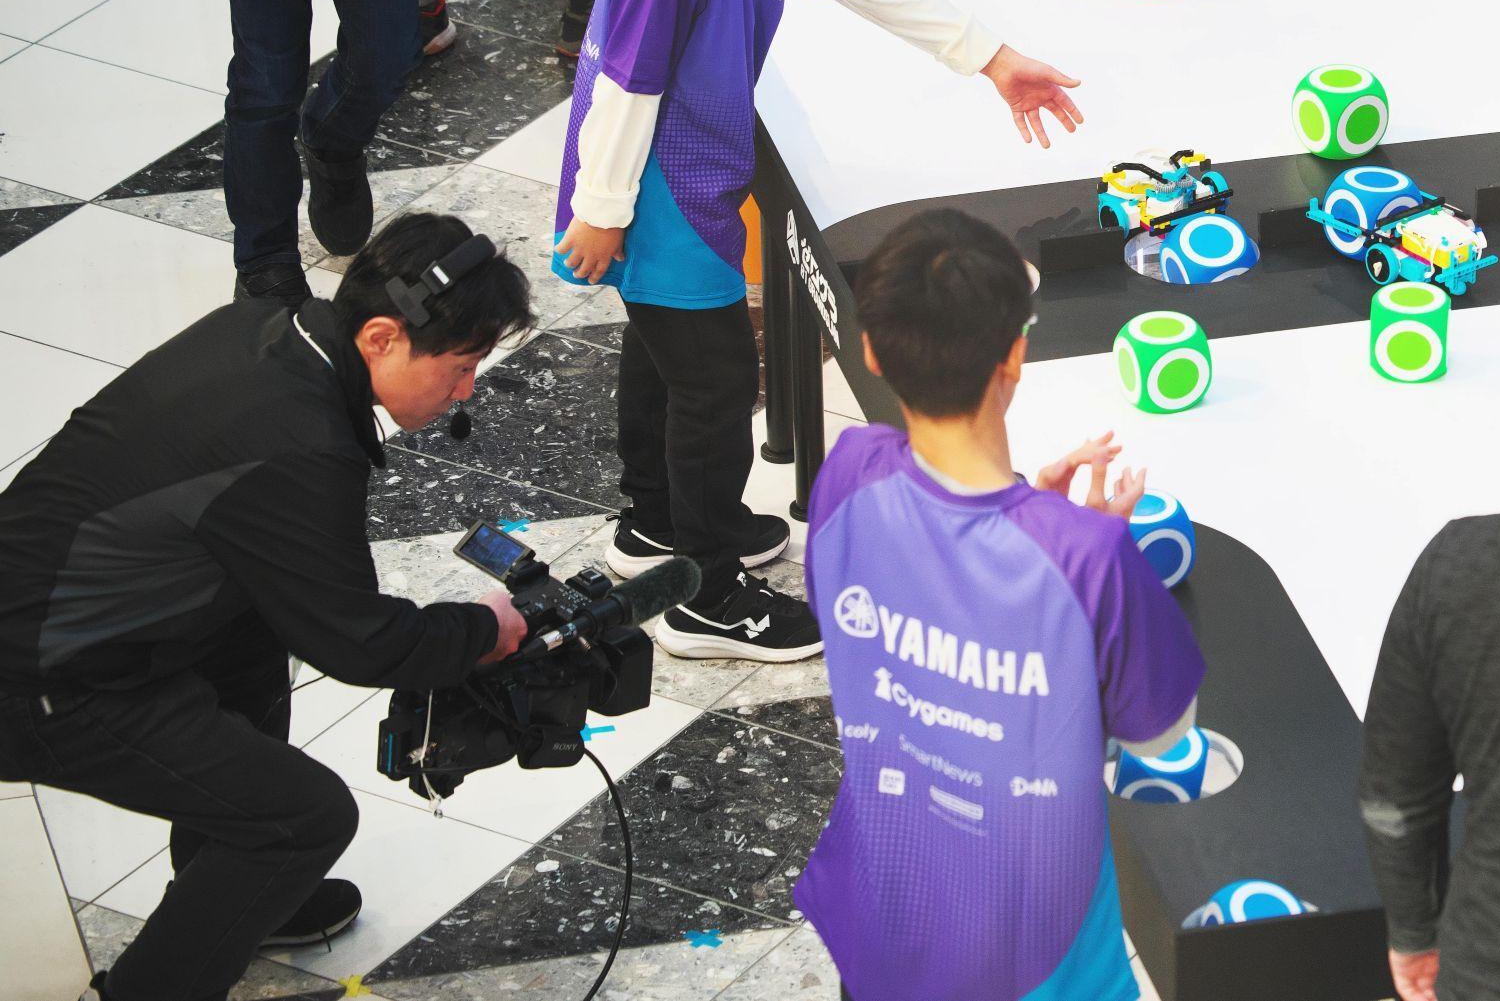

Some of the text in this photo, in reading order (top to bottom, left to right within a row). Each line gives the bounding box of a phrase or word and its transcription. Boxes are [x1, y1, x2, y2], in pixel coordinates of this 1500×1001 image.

[879, 605, 1049, 697] YAMAHA
[844, 722, 879, 743] coly
[891, 682, 1004, 741] Cygames
